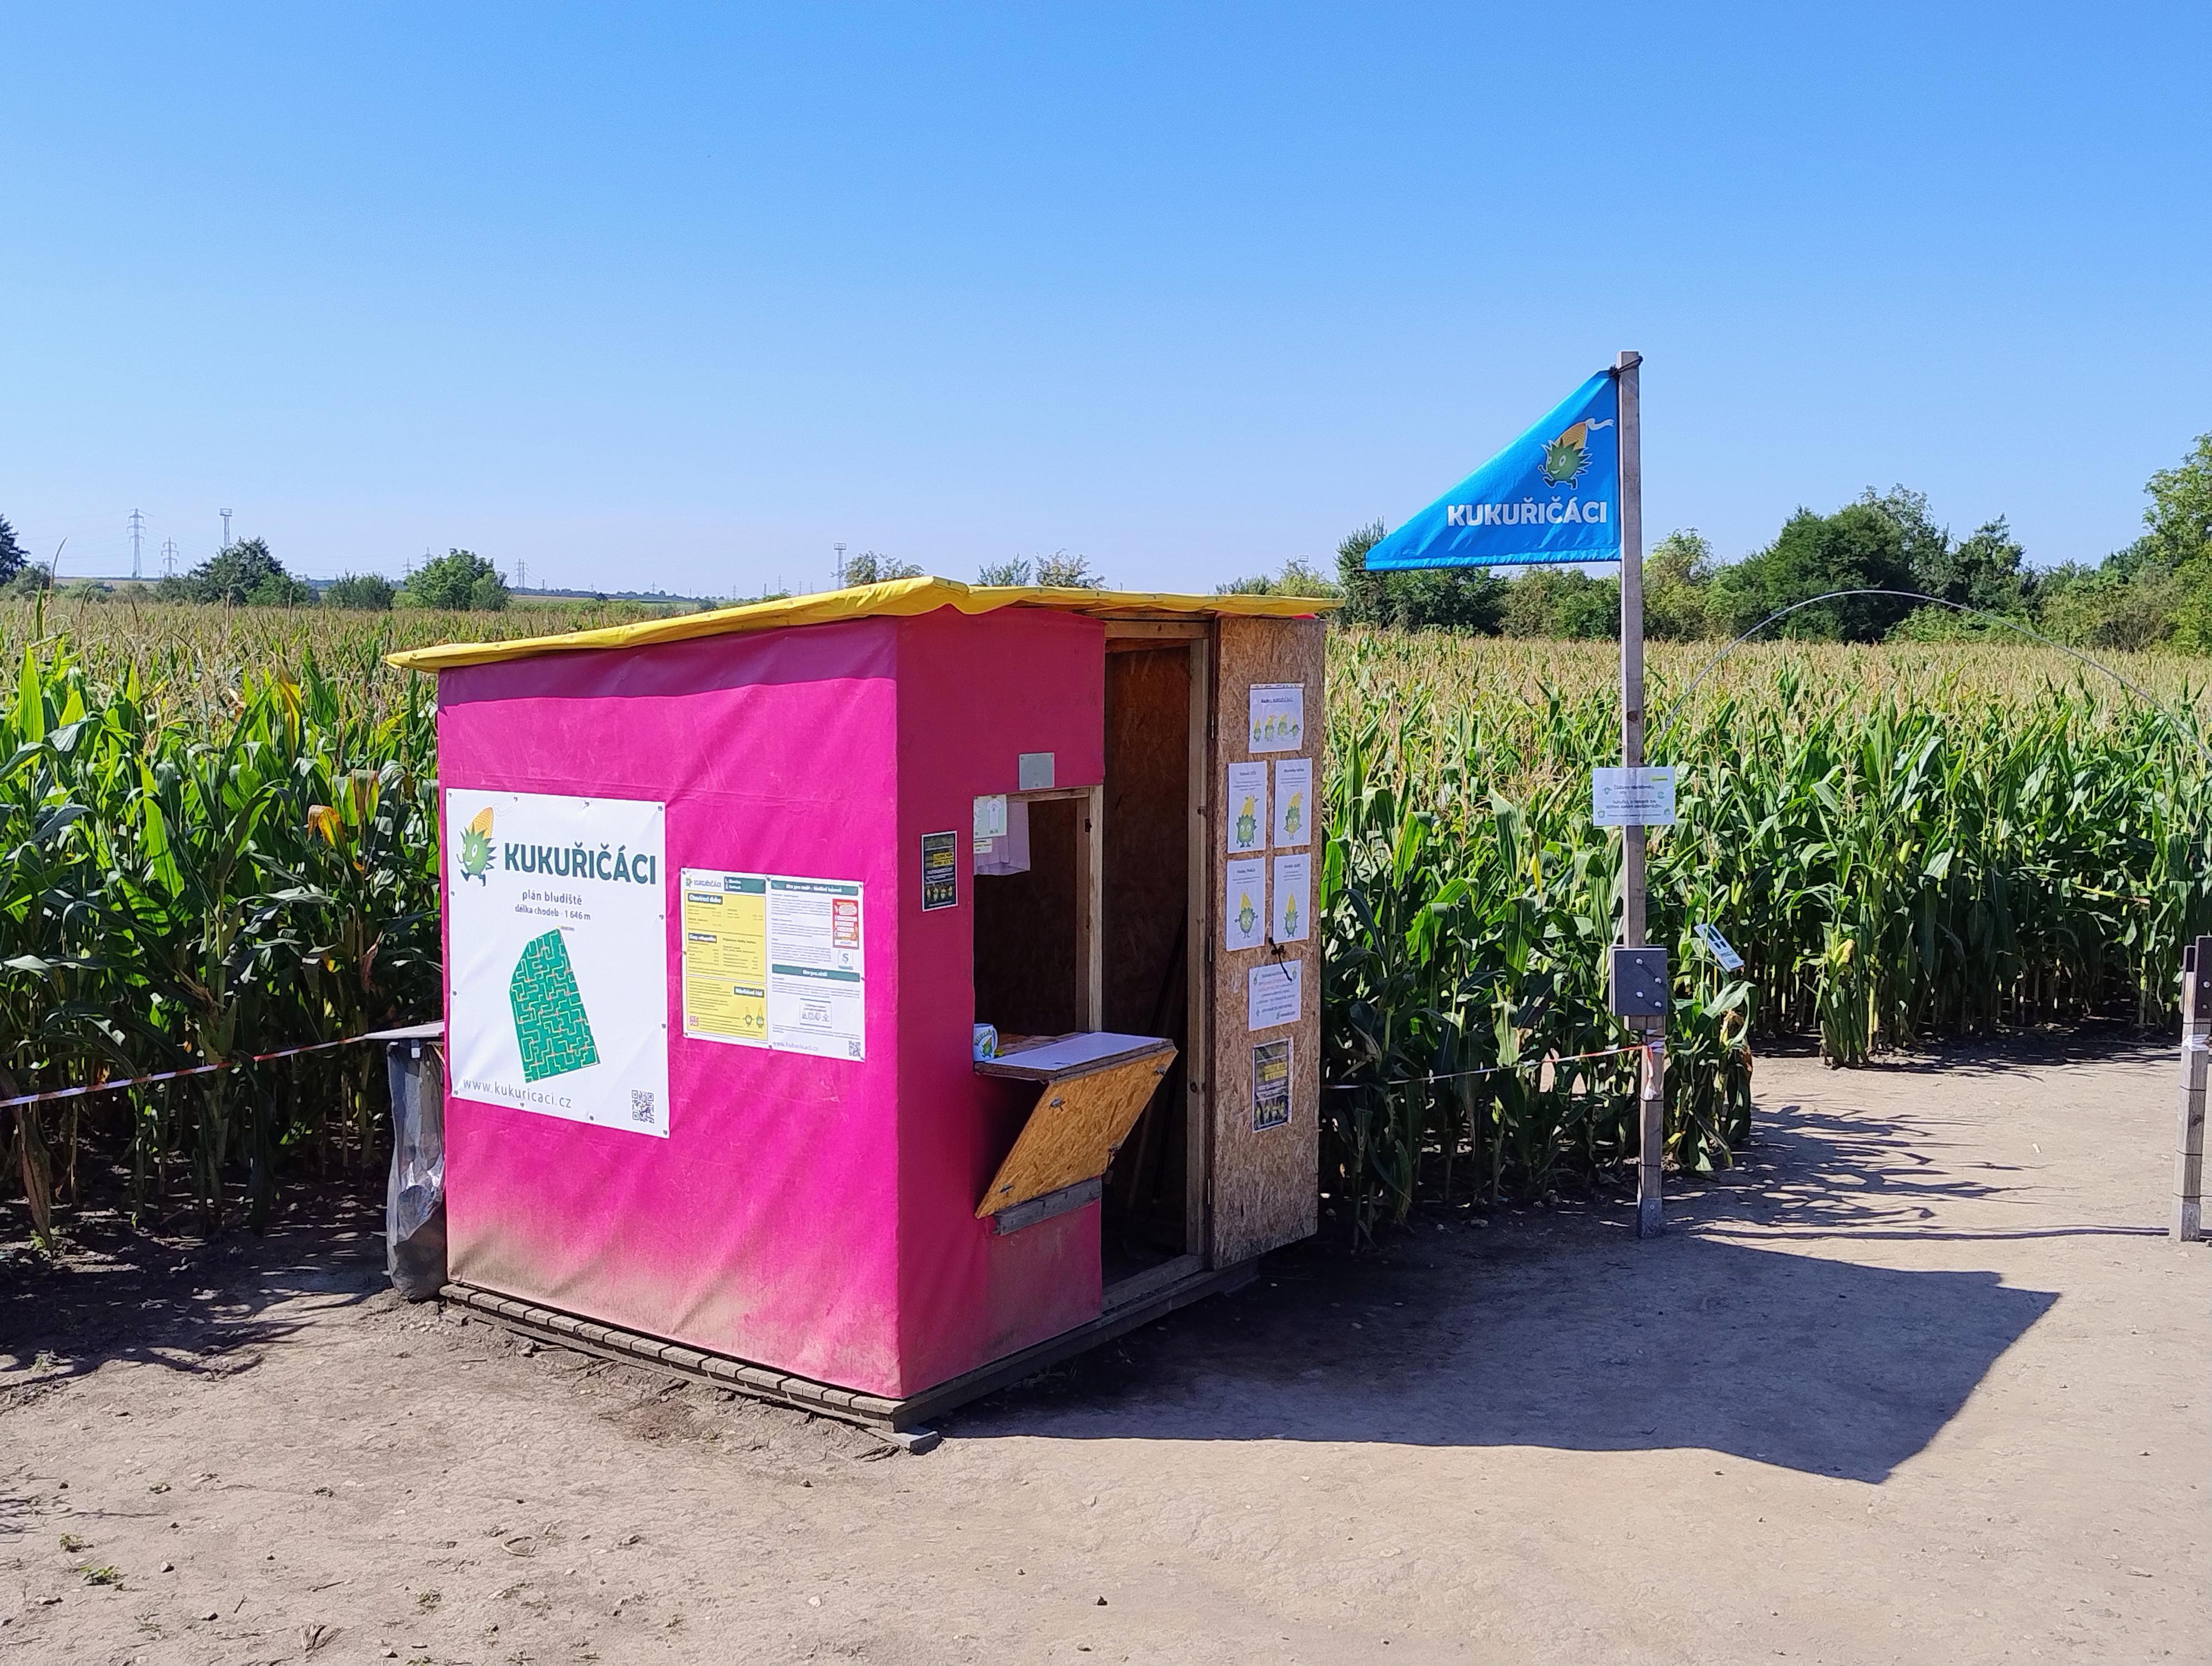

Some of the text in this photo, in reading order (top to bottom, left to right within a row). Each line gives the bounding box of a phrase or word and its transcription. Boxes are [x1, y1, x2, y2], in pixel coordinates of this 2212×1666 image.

[1447, 496, 1607, 526] KUKUŘIČÁCI
[504, 841, 657, 885] KUKUŘIČÁCI
[522, 889, 582, 905] plán bludiště
[534, 906, 559, 917] chodeb
[463, 1079, 572, 1108] www.kukuricaci.cz
